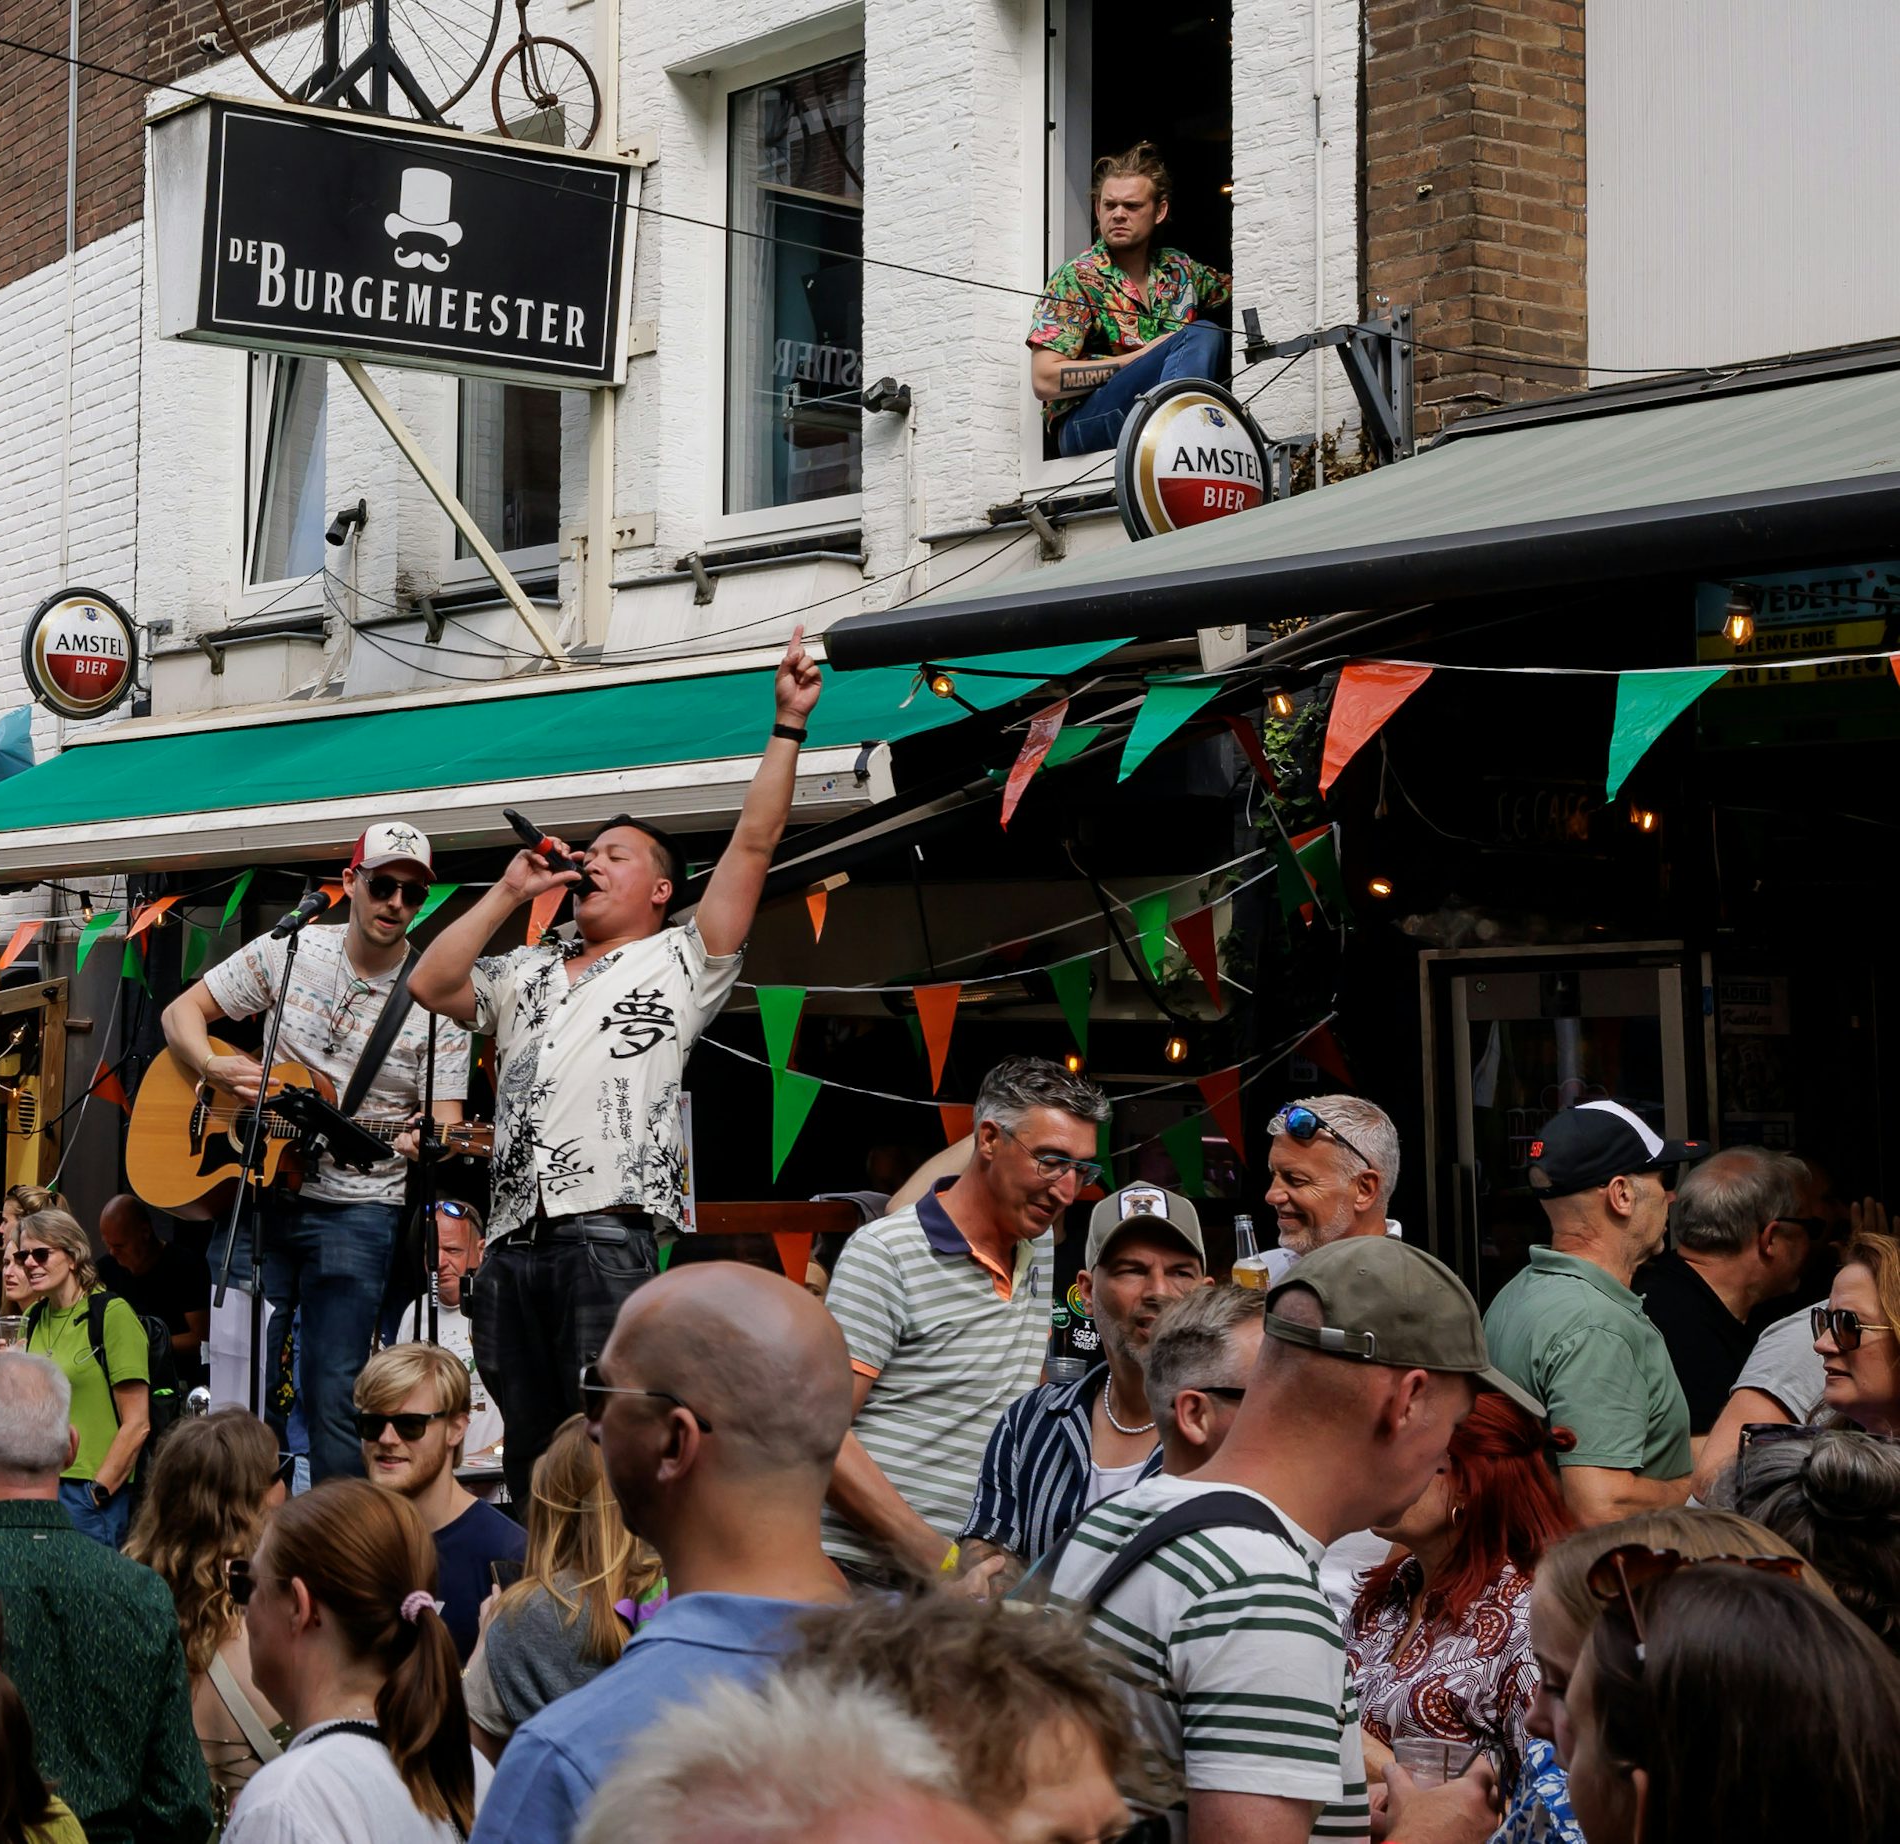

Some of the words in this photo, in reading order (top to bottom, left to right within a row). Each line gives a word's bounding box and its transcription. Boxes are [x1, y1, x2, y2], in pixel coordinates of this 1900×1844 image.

[228, 236, 258, 266] DE
[1171, 446, 1261, 483] AMSTEL
[1203, 486, 1246, 511] BIER
[55, 633, 125, 657] AMSTEL
[75, 660, 109, 676] BIER
[1768, 667, 1790, 681] LE
[599, 987, 676, 1060] 夢
